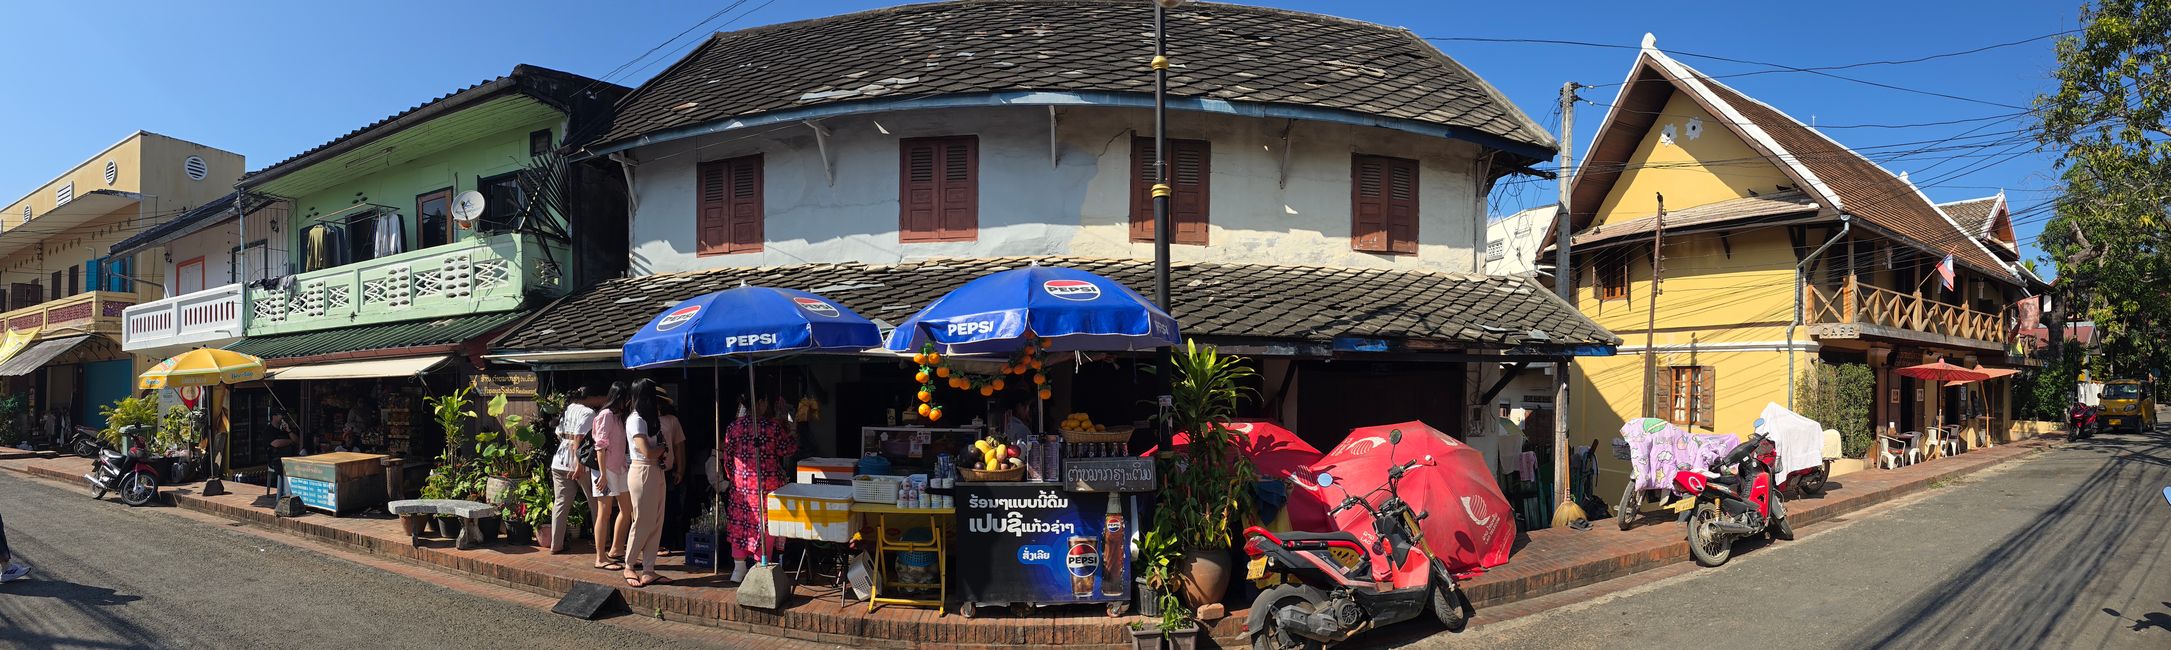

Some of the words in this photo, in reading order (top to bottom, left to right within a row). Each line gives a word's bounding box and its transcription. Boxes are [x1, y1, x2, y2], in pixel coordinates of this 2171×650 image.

[1047, 286, 1096, 294] PEPSI
[800, 303, 833, 311] PEPSI
[662, 311, 694, 323] PEPSI
[948, 320, 994, 336] PEPSI
[1822, 327, 1855, 337] CAFE
[725, 333, 777, 348] PEPSI
[1068, 556, 1098, 564] PEPSI
